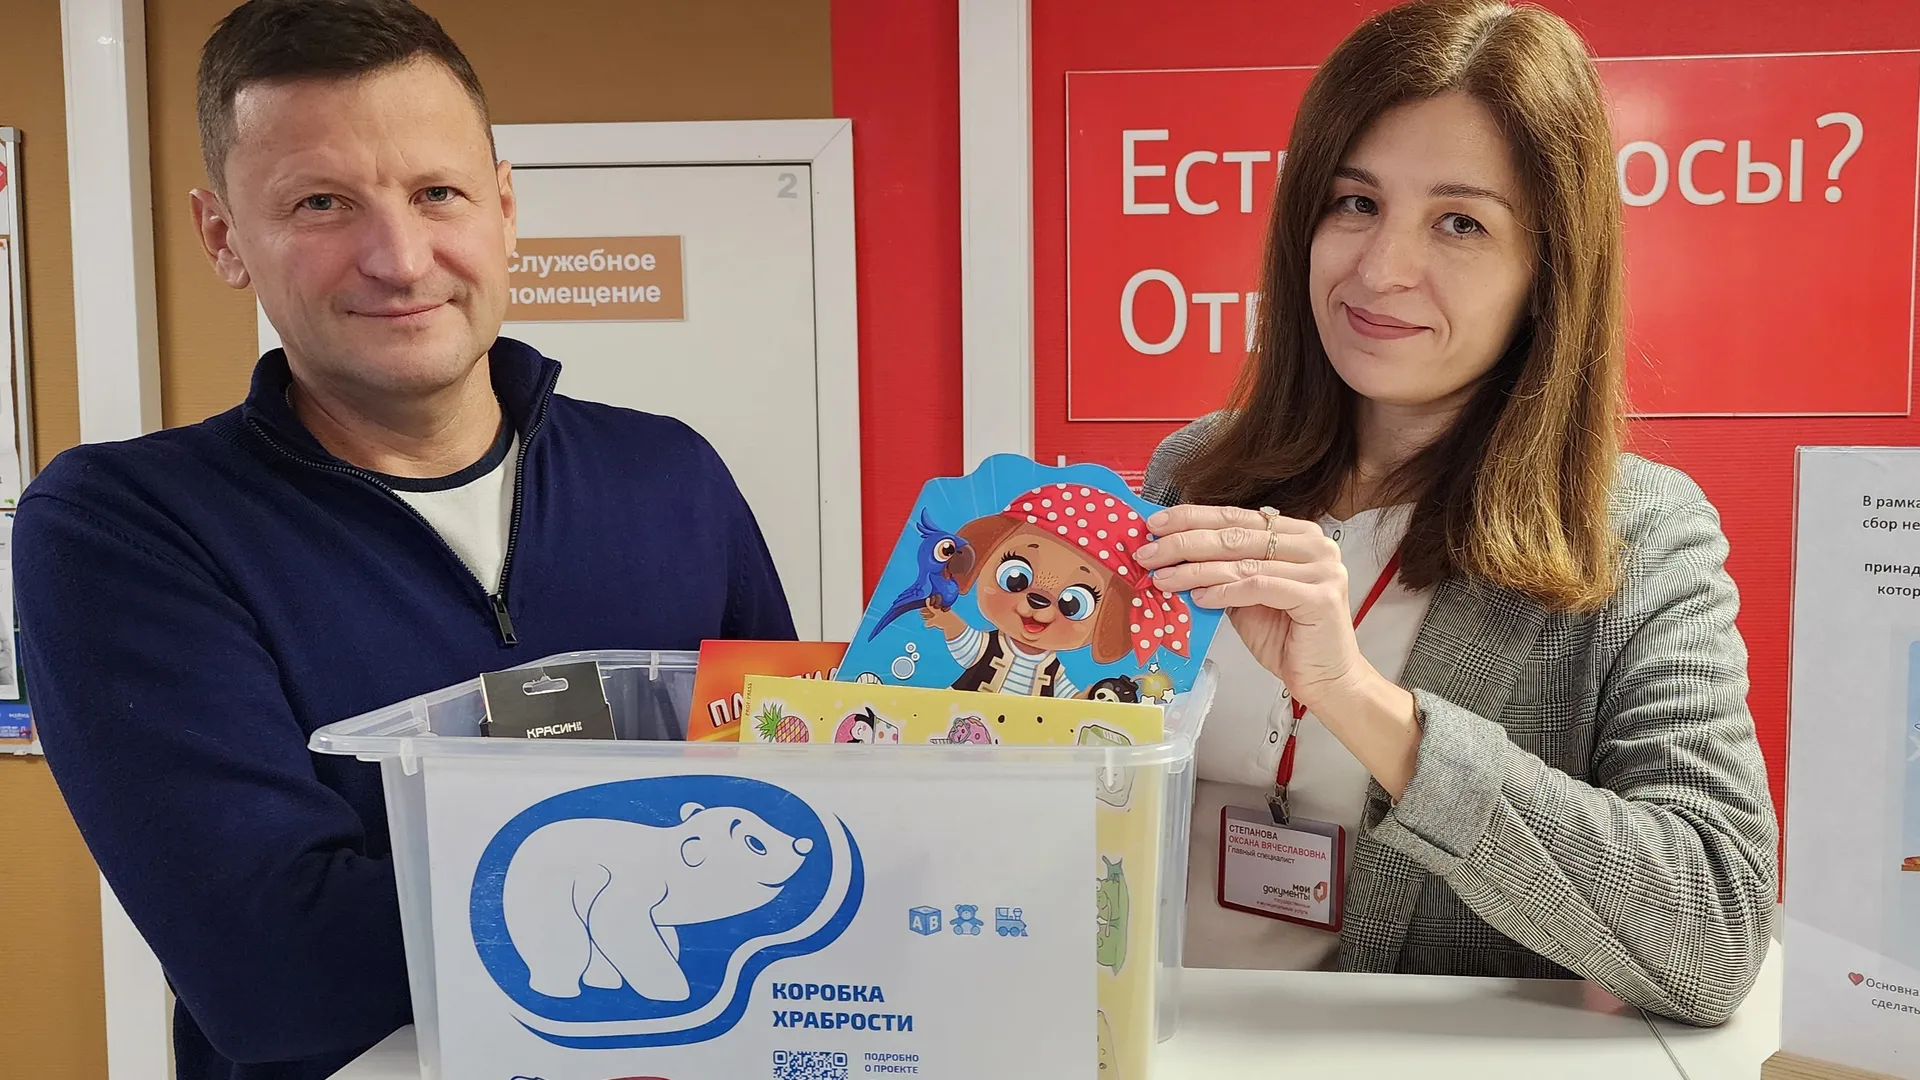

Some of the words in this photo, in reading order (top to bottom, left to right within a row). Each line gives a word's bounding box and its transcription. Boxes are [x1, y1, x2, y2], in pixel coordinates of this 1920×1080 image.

[1122, 129, 1287, 216] Ест
[1616, 112, 1864, 207] осы?
[777, 172, 798, 199] 2
[507, 249, 656, 277] Служебное
[1862, 495, 1871, 506] В
[1862, 517, 1897, 531] сбор
[1903, 521, 1920, 530] не
[1865, 563, 1920, 576] принад
[1878, 585, 1920, 598] котор
[526, 721, 577, 739] КРАСИН
[1229, 824, 1278, 840] СТЕПАНОВА
[1228, 835, 1260, 848] ОКСАНА
[1261, 842, 1326, 860] ВЯЧЕСЛАВОВНА
[1228, 846, 1256, 858] Главный
[1256, 852, 1295, 865] специалист
[1263, 885, 1311, 901] документы
[772, 982, 885, 1002] КОРОБКА
[1866, 978, 1919, 996] Основна
[1871, 998, 1920, 1014] сделать
[772, 1010, 913, 1032] ХРАБРОСТИ
[864, 1052, 919, 1062] ПОДРОБНО
[864, 1064, 872, 1073] О
[873, 1065, 918, 1074] ПРОЕКТЕ
